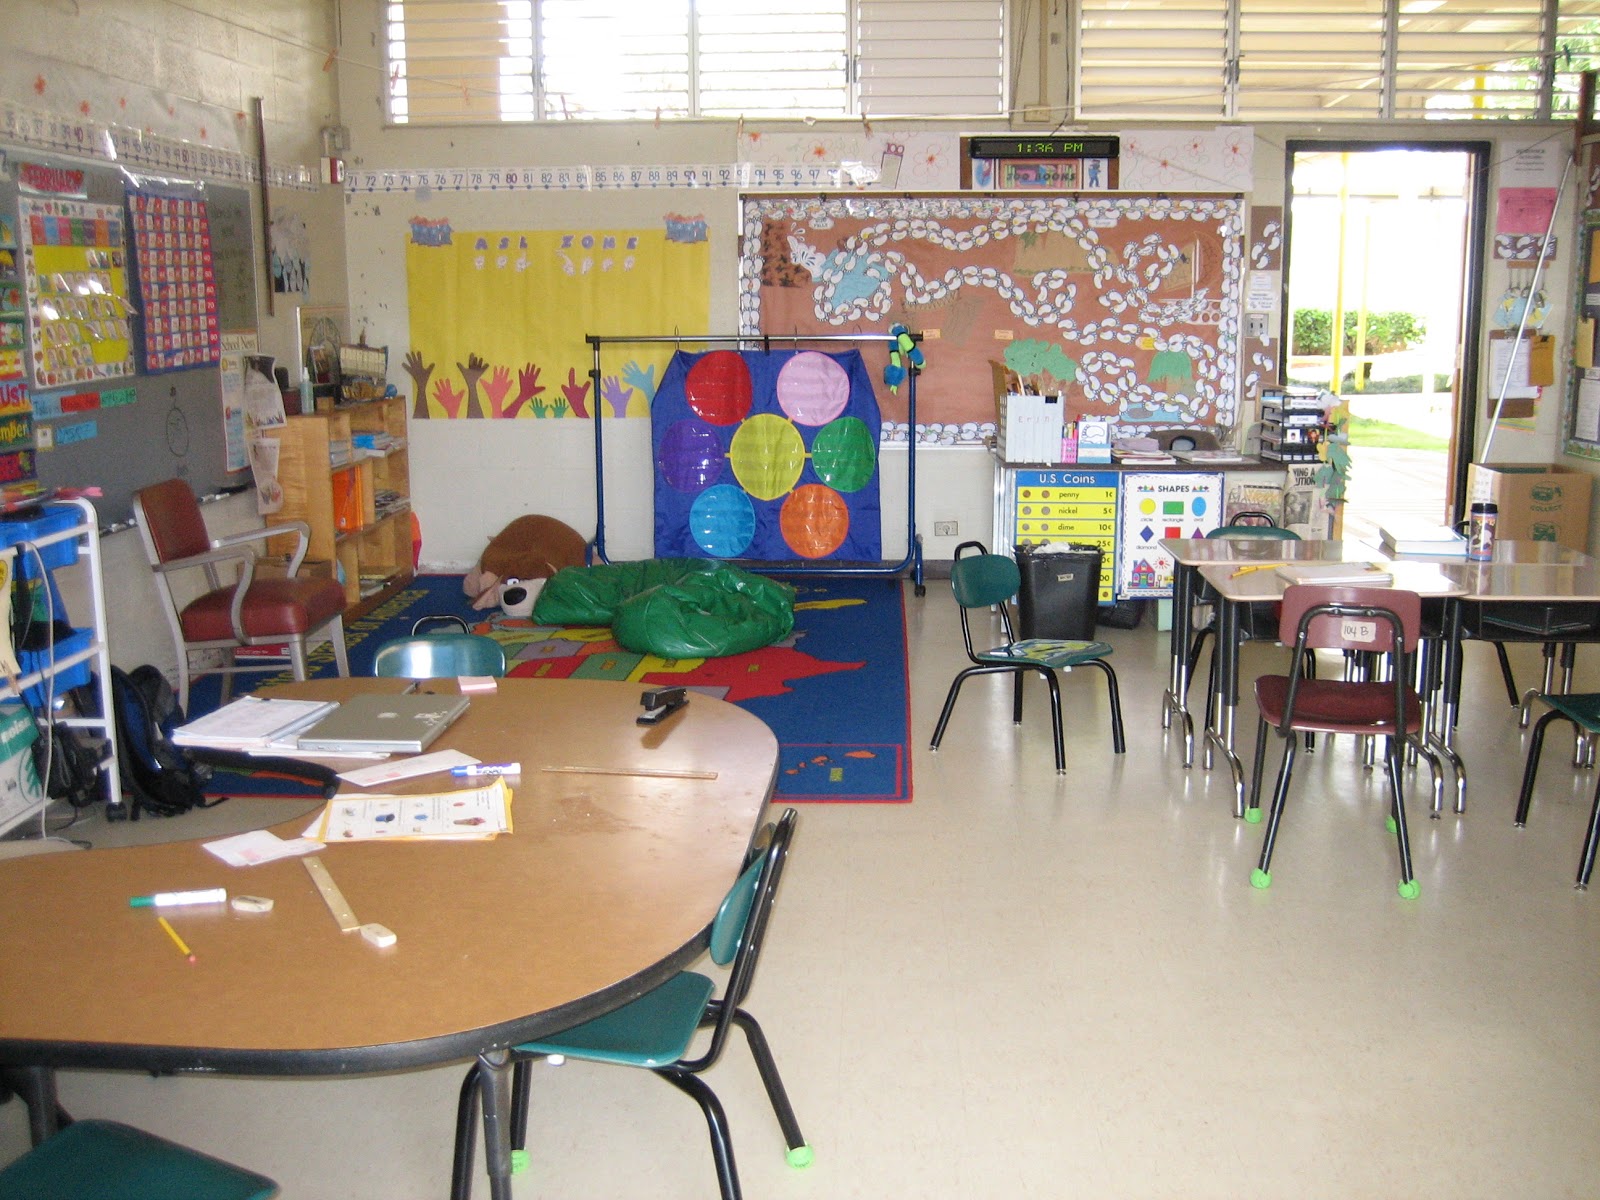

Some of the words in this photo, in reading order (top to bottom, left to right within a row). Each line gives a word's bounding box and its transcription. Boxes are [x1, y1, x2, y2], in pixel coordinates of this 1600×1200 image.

[886, 142, 905, 155] 100
[1017, 143, 1054, 153] 1:36
[1063, 143, 1084, 153] PM
[348, 176, 358, 186] 71
[366, 176, 377, 186] 72
[383, 175, 394, 186] 73
[400, 175, 412, 186] 74
[418, 175, 429, 185] 75
[435, 174, 447, 185] 76
[452, 174, 463, 184] 77
[471, 173, 482, 183] 78
[488, 173, 500, 184] 79
[505, 173, 518, 183] 80
[523, 173, 533, 183] 81
[541, 173, 553, 183] 82
[559, 173, 570, 183] 83
[576, 172, 587, 183] 84
[595, 171, 607, 182] 85
[613, 171, 625, 181] 86
[631, 171, 642, 181] 87
[648, 171, 660, 181] 88
[666, 171, 678, 181] 89
[702, 170, 712, 181] 91
[719, 169, 730, 180] 92
[754, 169, 766, 180] 94
[772, 169, 784, 180] 95
[790, 169, 803, 180] 96
[808, 169, 820, 180] 97
[1039, 473, 1059, 484] U.S.
[1063, 473, 1096, 484] Coins
[1158, 485, 1190, 493] SHAPES
[1057, 523, 1075, 531] dime
[1343, 625, 1357, 638] 104
[1359, 626, 1369, 636] B
